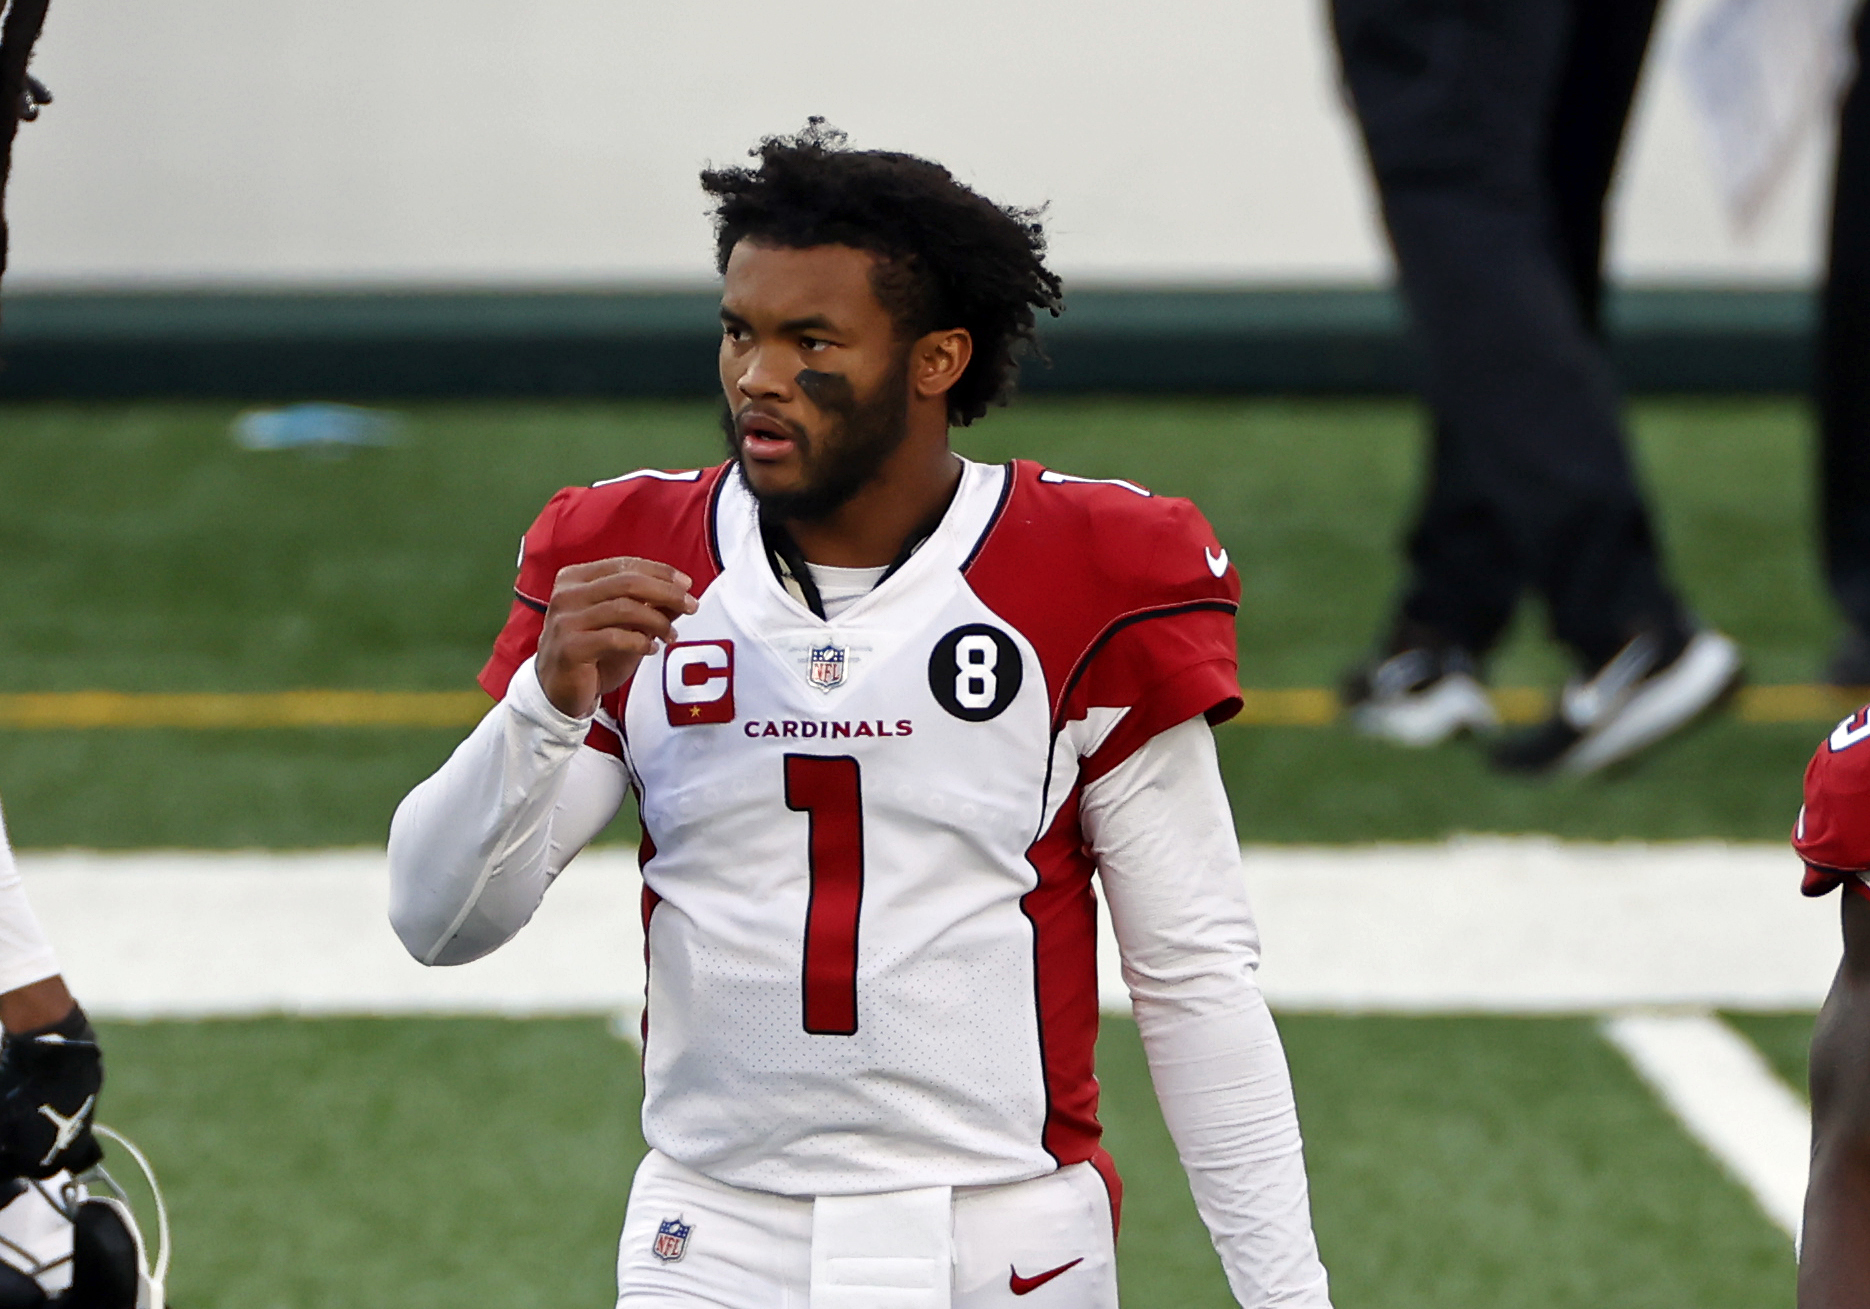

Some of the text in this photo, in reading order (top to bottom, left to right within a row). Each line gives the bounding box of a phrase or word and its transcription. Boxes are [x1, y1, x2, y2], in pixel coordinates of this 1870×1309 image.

[666, 643, 729, 705] C
[812, 663, 840, 682] NFL
[955, 634, 998, 709] 8
[744, 719, 913, 739] CARDINALS
[783, 753, 864, 1036] 1
[656, 1234, 681, 1256] NFL
